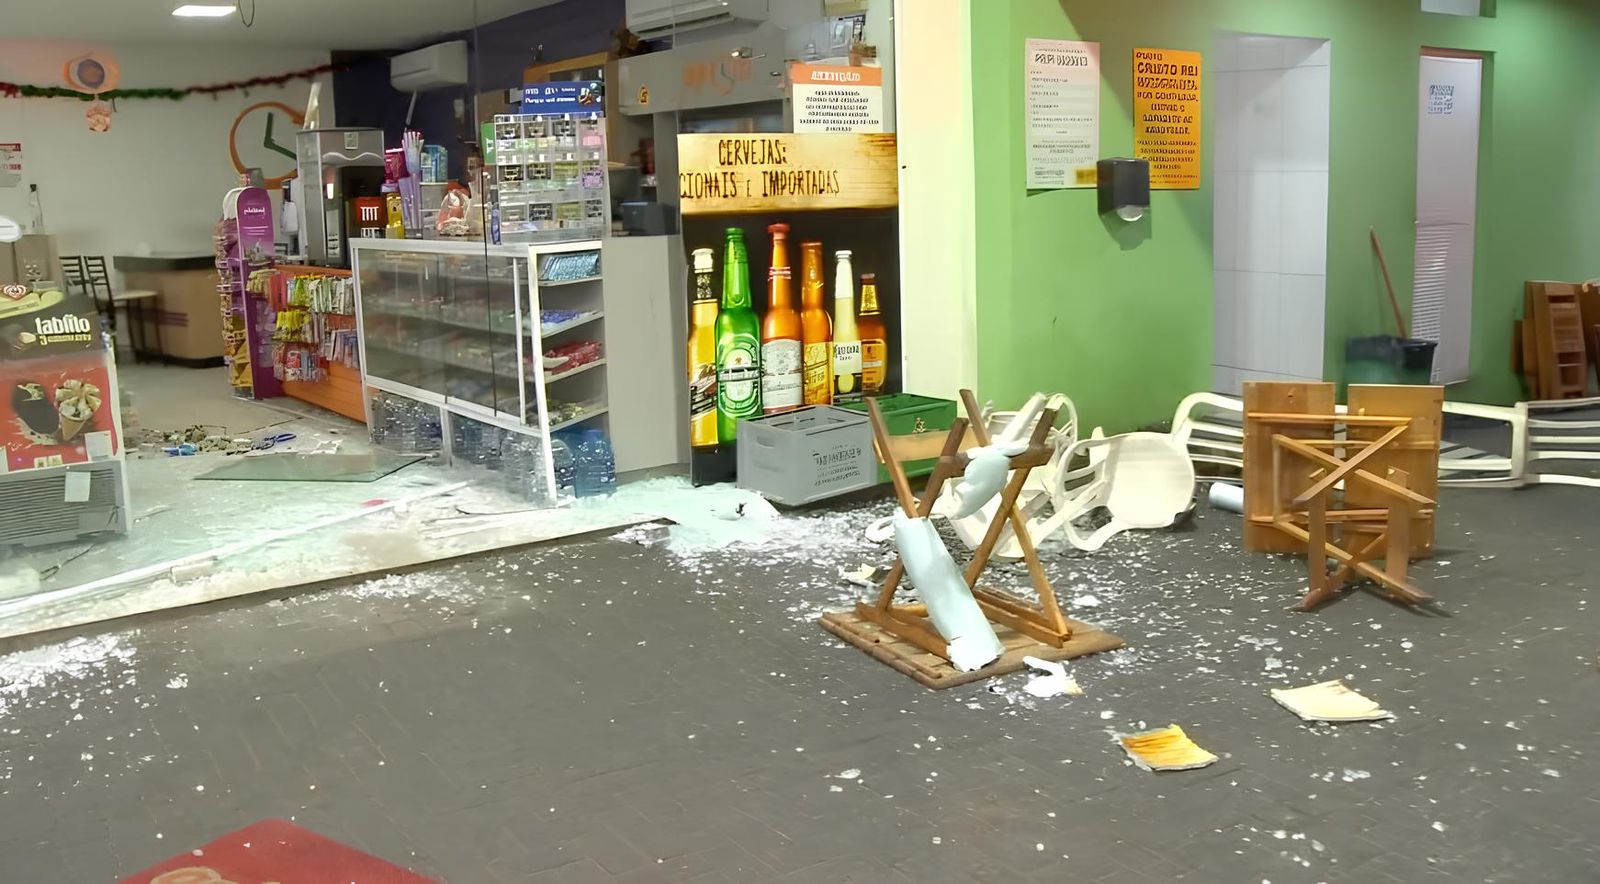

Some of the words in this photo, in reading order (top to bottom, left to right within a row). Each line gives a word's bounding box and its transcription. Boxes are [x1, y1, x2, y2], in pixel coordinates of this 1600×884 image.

[719, 139, 787, 165] CERVEJAS:
[679, 171, 738, 198] CIONAIS
[762, 170, 840, 197] IMPORTADAS
